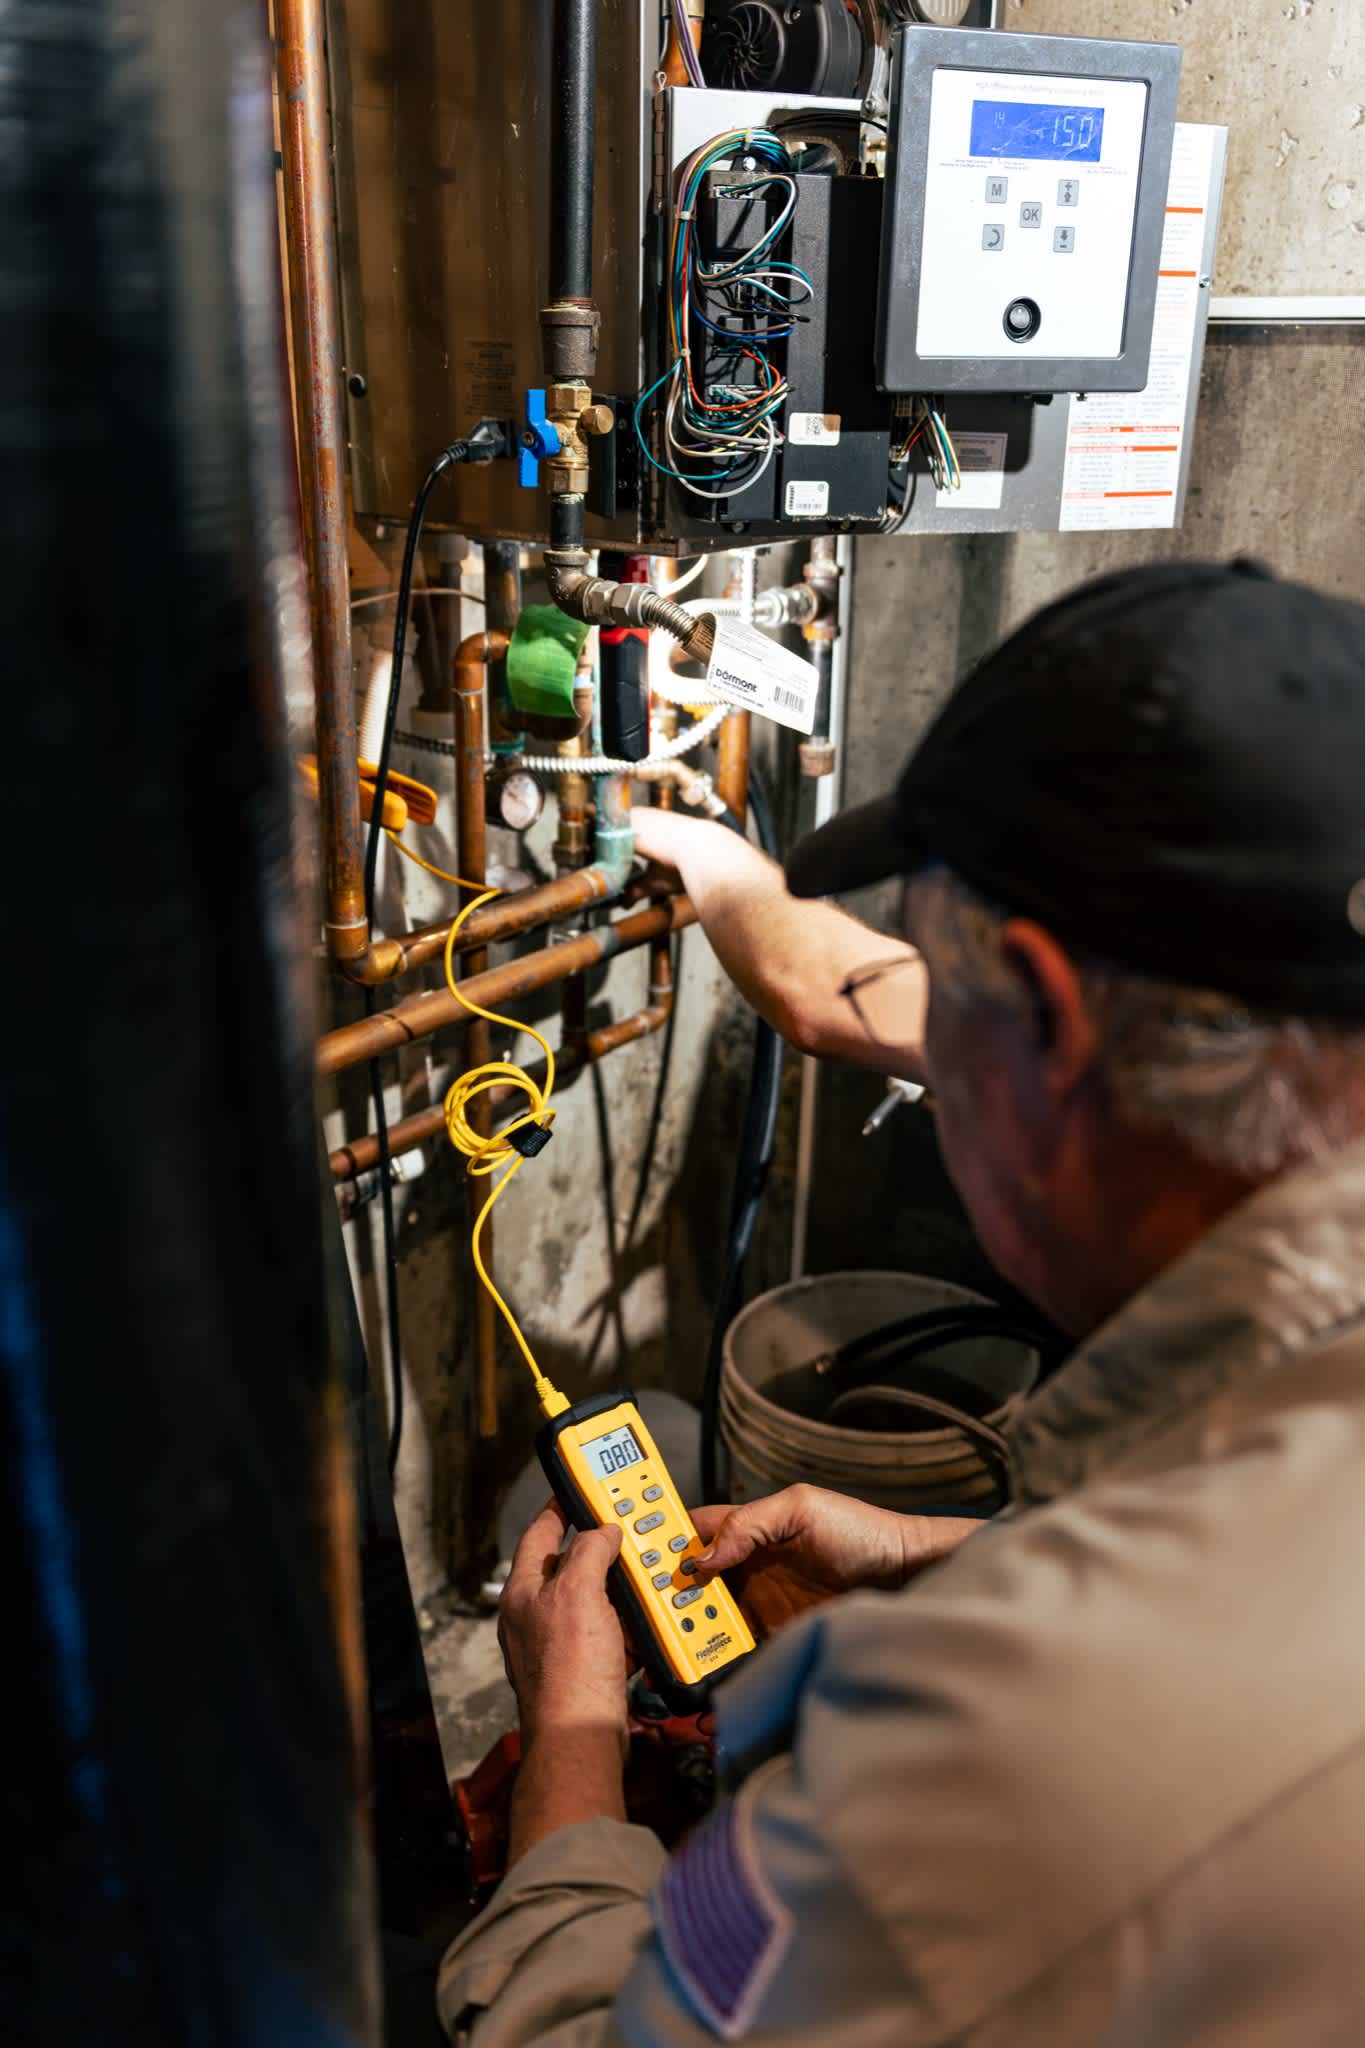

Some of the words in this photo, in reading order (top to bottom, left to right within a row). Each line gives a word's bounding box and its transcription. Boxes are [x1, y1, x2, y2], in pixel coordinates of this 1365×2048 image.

[1052, 114, 1095, 149] 150
[991, 183, 1003, 196] M
[1022, 208, 1040, 221] OK
[599, 1439, 640, 1475] 080
